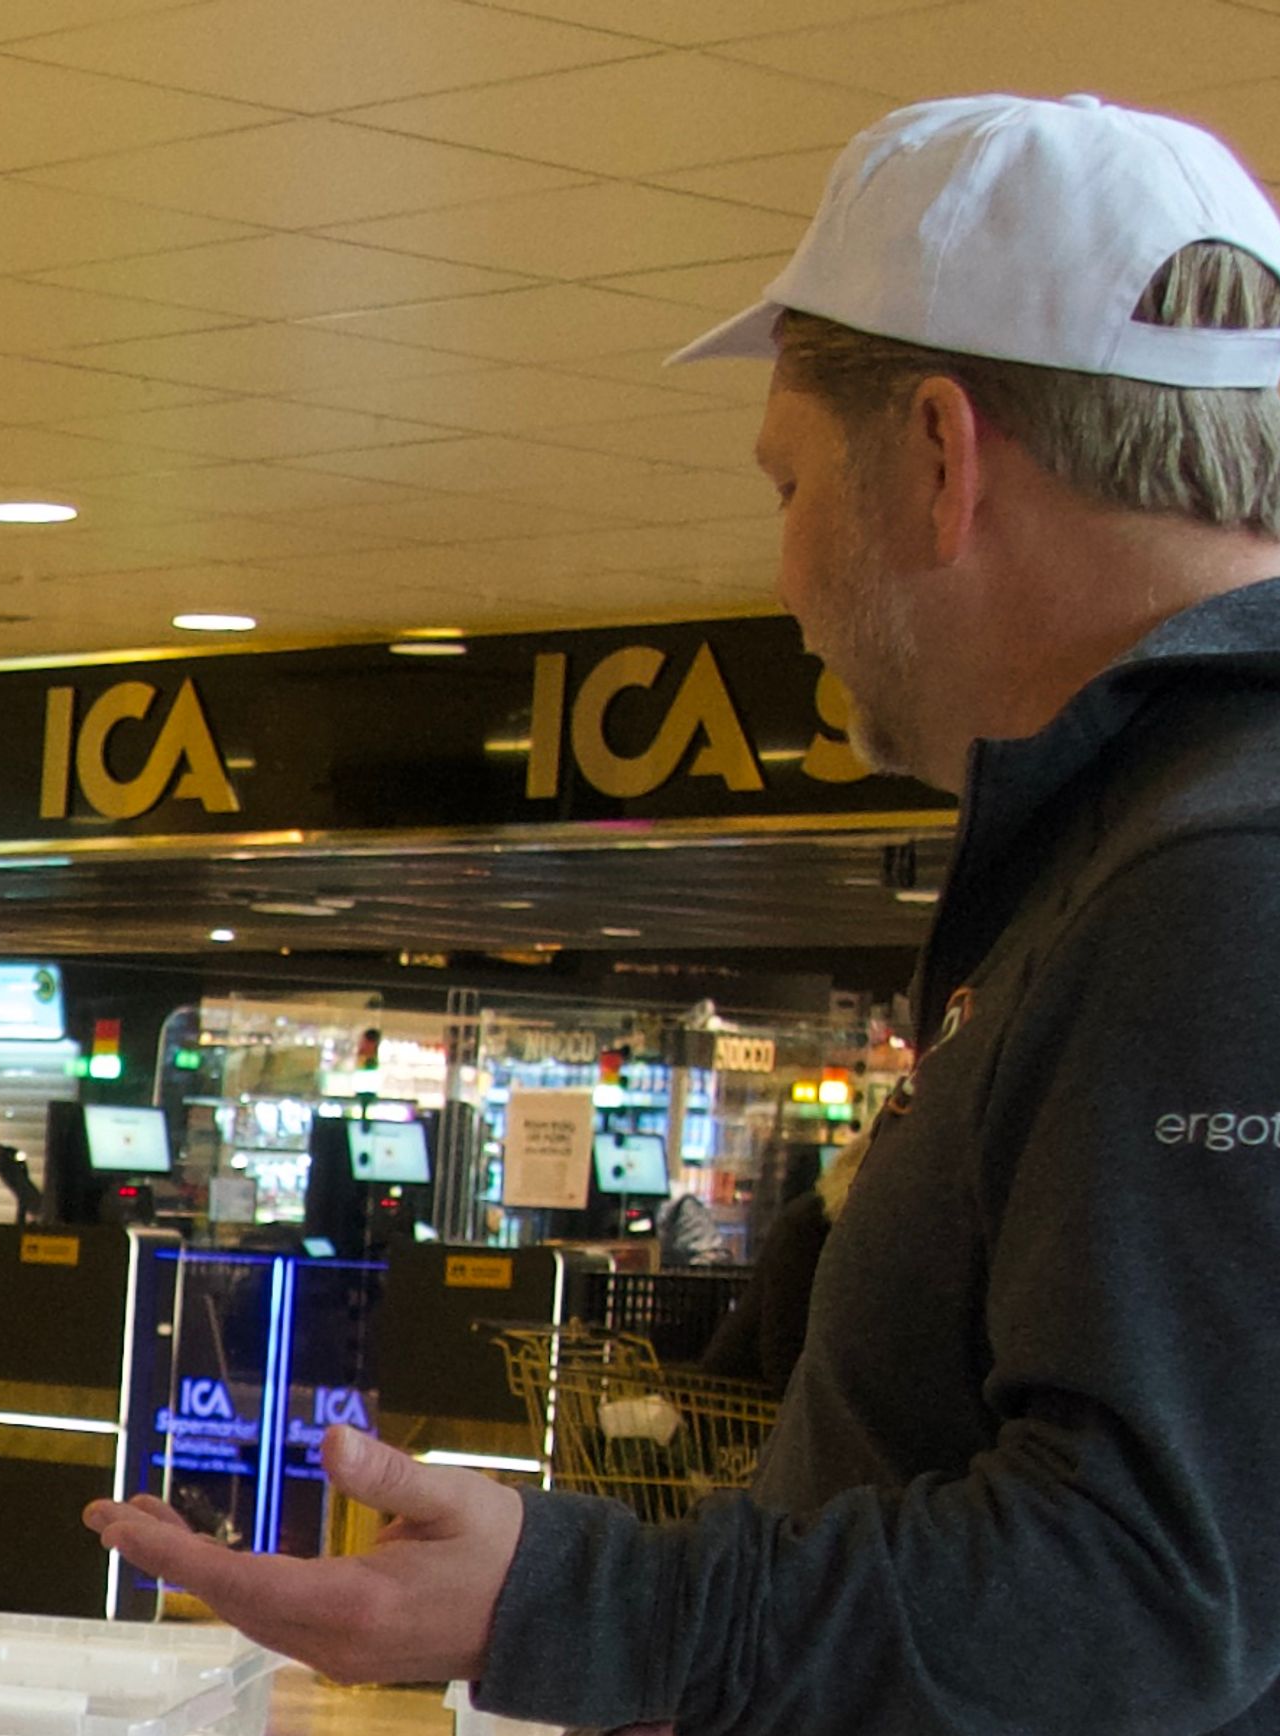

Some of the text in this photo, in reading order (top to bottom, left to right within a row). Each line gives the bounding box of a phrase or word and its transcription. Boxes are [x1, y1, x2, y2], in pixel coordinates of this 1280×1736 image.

[39, 676, 241, 820] ICA
[525, 640, 765, 799] ICA
[179, 1376, 234, 1419] ICA
[313, 1385, 370, 1429] ICA
